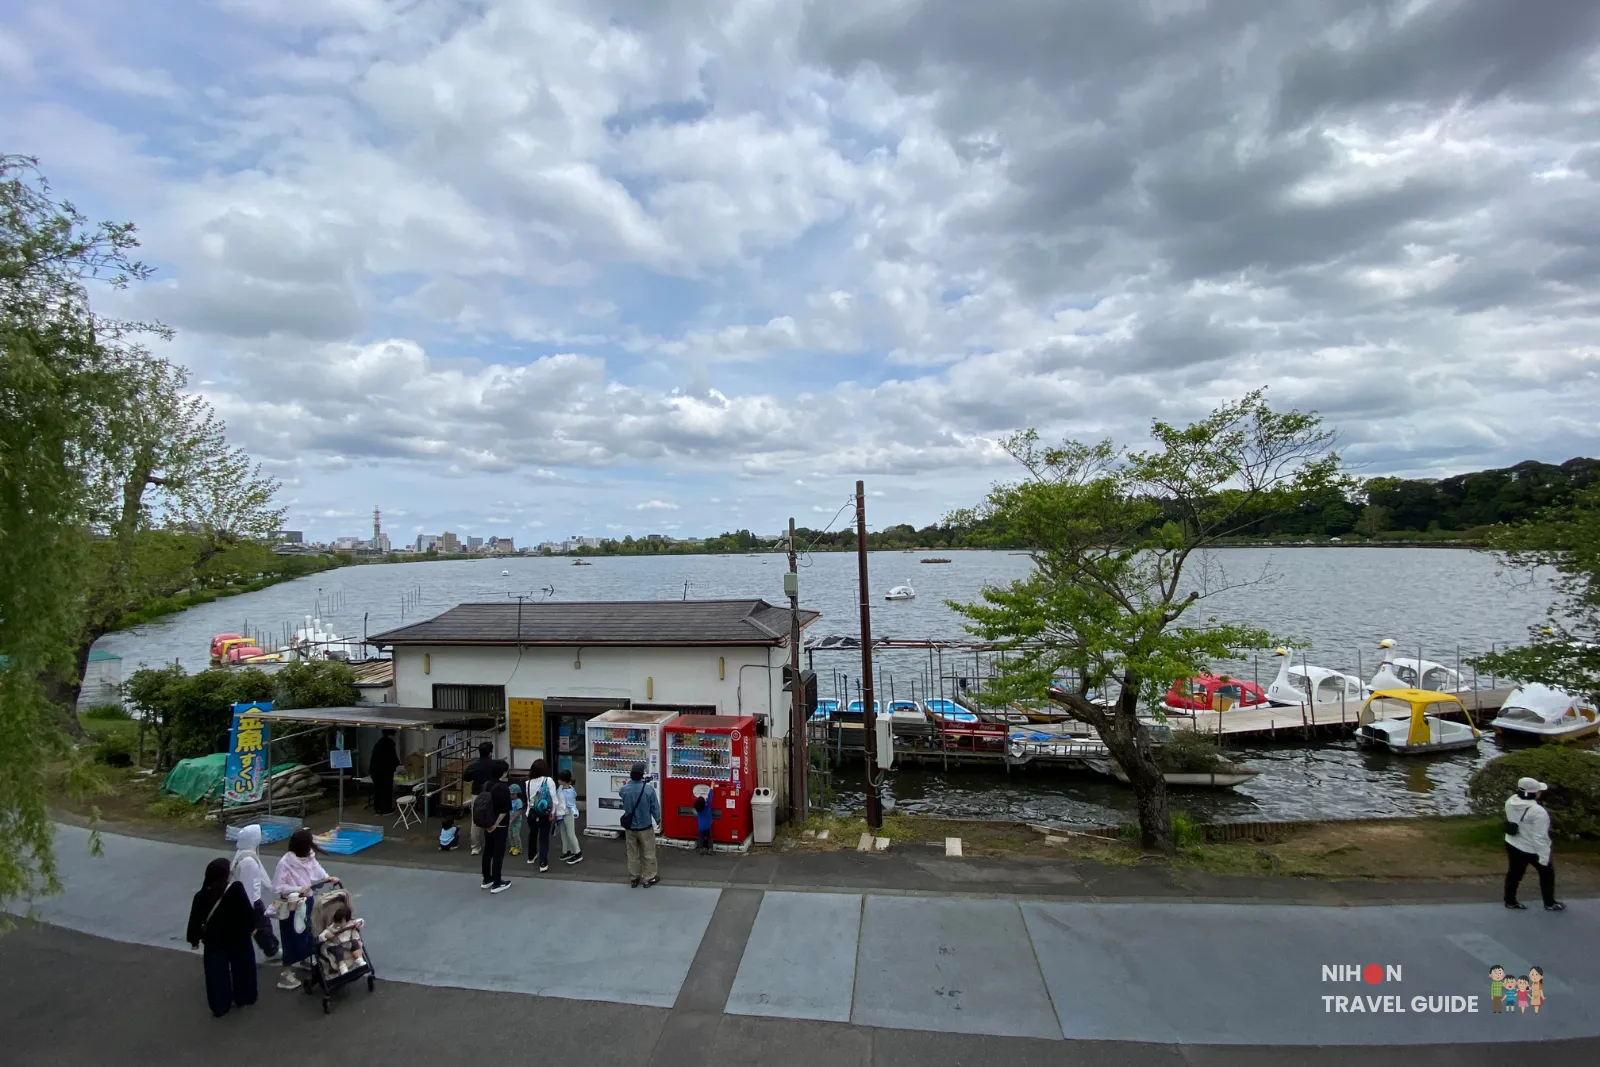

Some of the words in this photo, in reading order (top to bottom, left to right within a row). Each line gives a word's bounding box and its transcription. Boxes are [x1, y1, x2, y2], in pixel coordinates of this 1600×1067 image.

[234, 707, 264, 793] 金魚すくい
